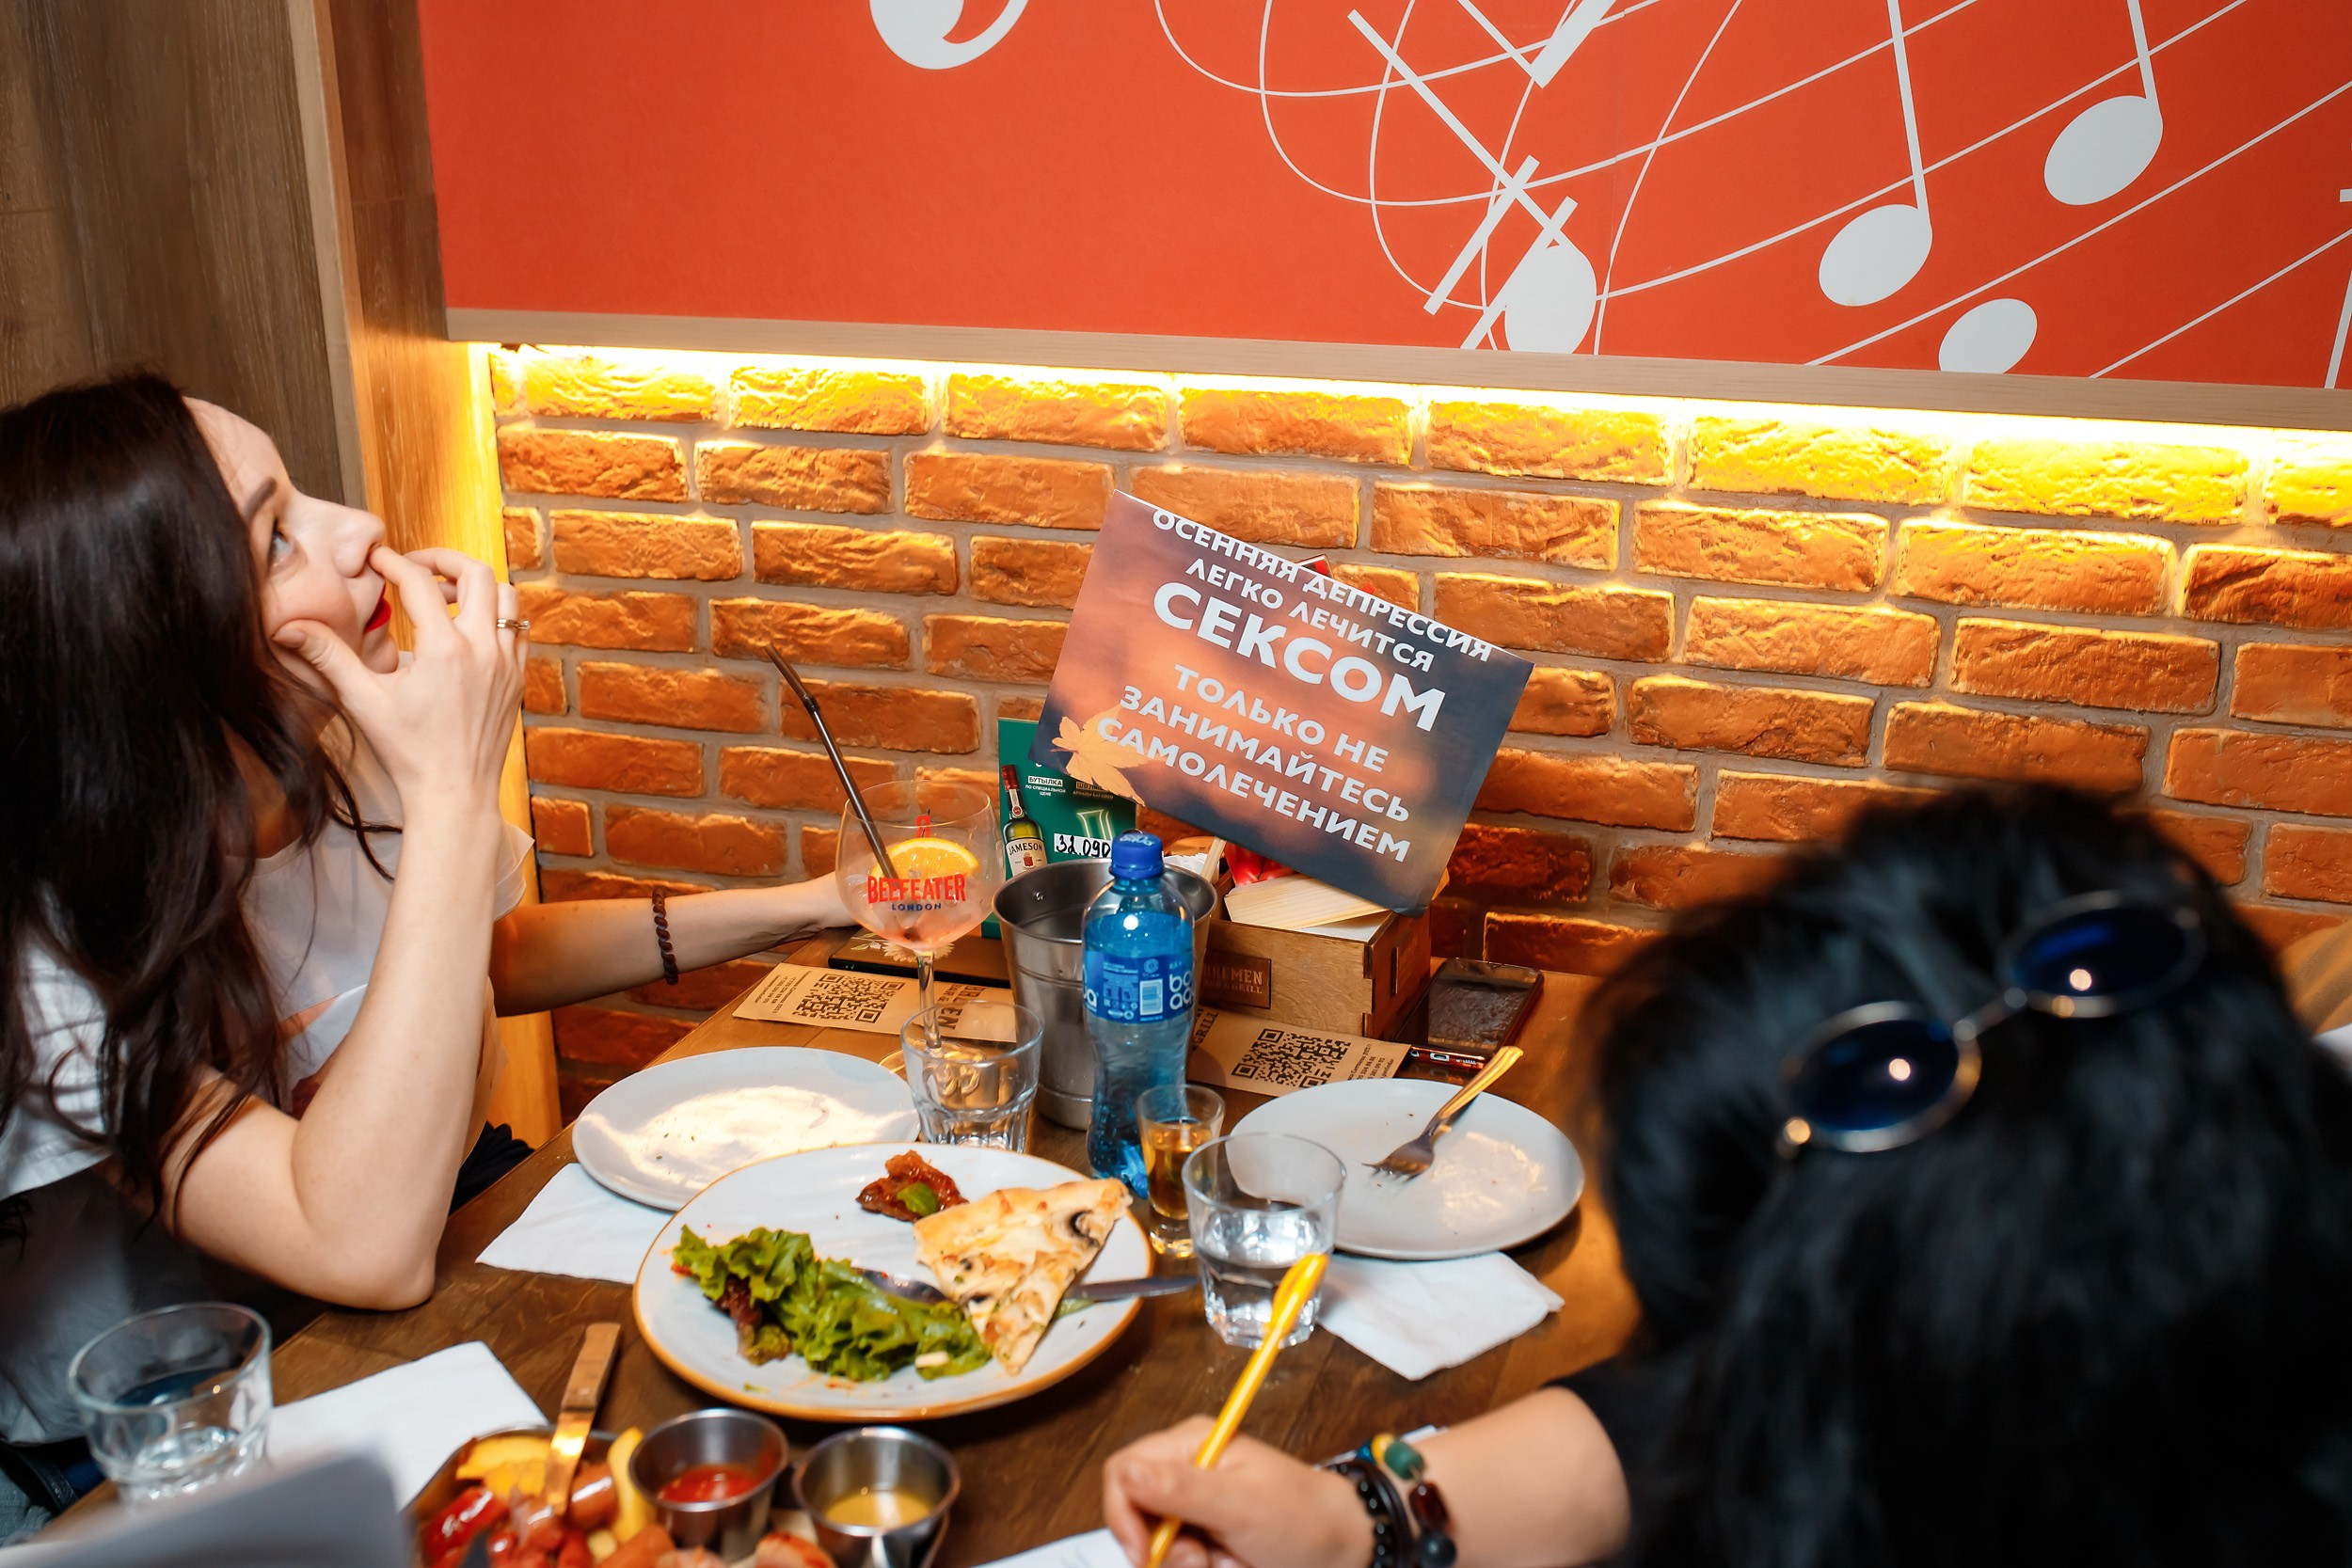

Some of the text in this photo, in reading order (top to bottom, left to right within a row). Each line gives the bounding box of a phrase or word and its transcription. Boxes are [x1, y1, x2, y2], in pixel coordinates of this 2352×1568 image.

[1153, 510, 1493, 662] ОСЕННЯЯ ДЕПРЕССИЯ
[1185, 558, 1435, 673] ЛЕГКО ЛЕЧИТСЯ
[1153, 582, 1446, 732] СЕКСОМ
[1120, 685, 1410, 821] ЗАНИМАЙТЕСЬ
[1174, 664, 1389, 772] ТОЛЬКО НЕ
[1028, 776, 1062, 786] БУТЫЛКА
[1097, 718, 1411, 863] САМОЛЕЧЕНИЕМ
[867, 873, 967, 904] BEEFEATER
[1009, 842, 1042, 856] JAMESON
[891, 902, 942, 911] LONDON
